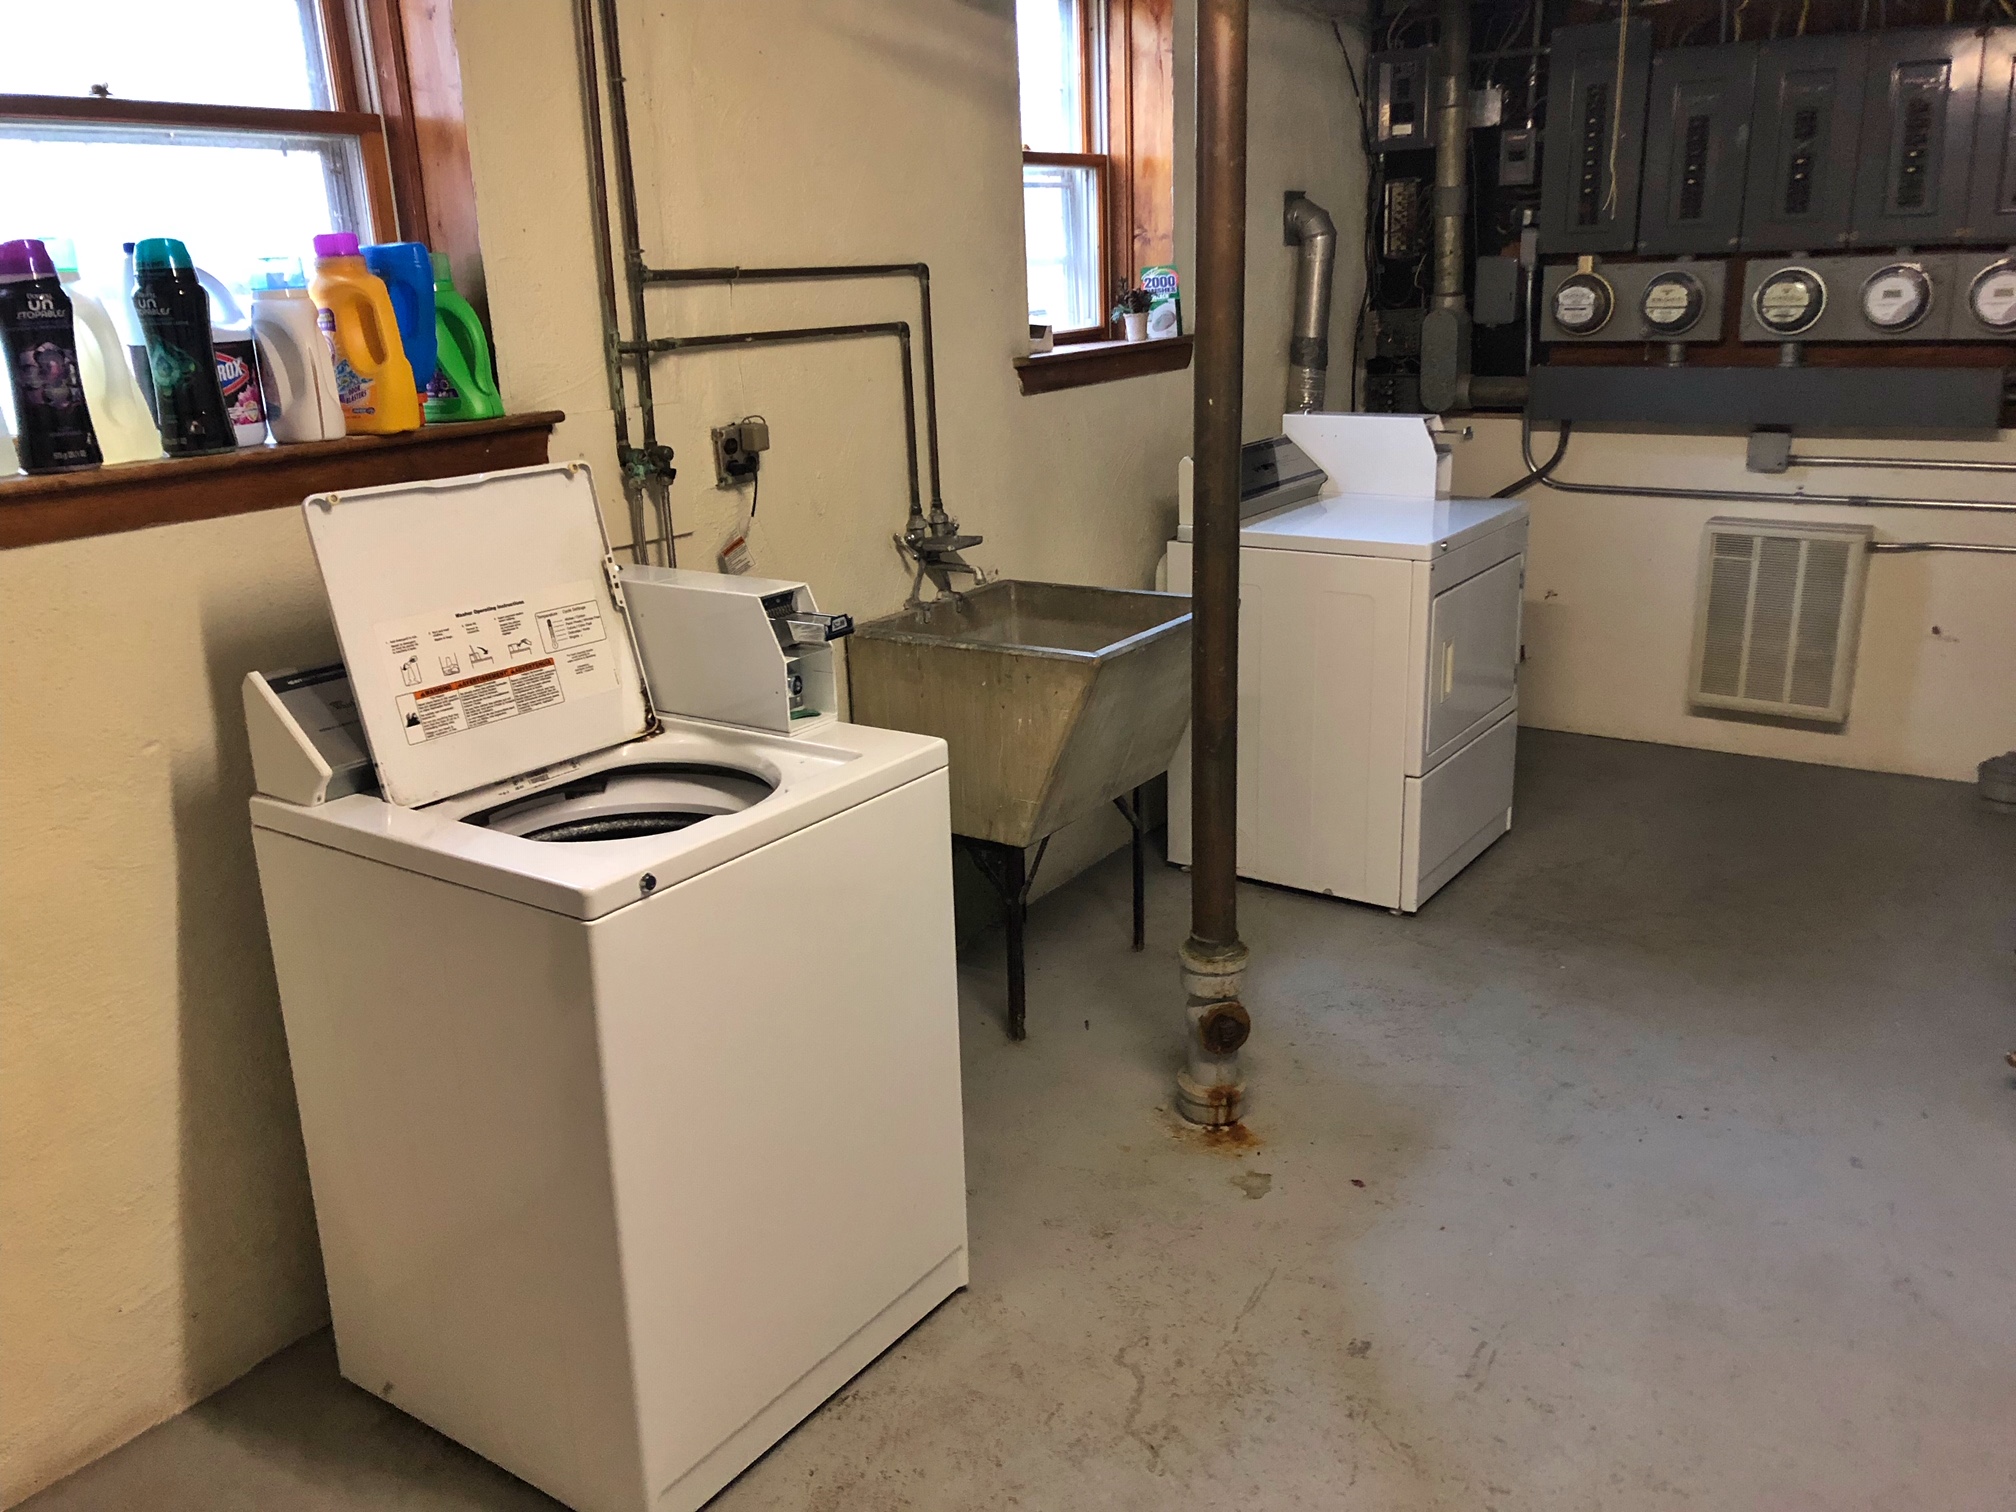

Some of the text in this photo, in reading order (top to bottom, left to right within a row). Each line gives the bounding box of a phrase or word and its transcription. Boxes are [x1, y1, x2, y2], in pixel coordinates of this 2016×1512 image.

[1144, 275, 1176, 289] 2000
[217, 357, 243, 382] ROX
[346, 390, 367, 404] BLASTERS
[473, 606, 497, 614] Operating
[497, 600, 525, 609] Instructions
